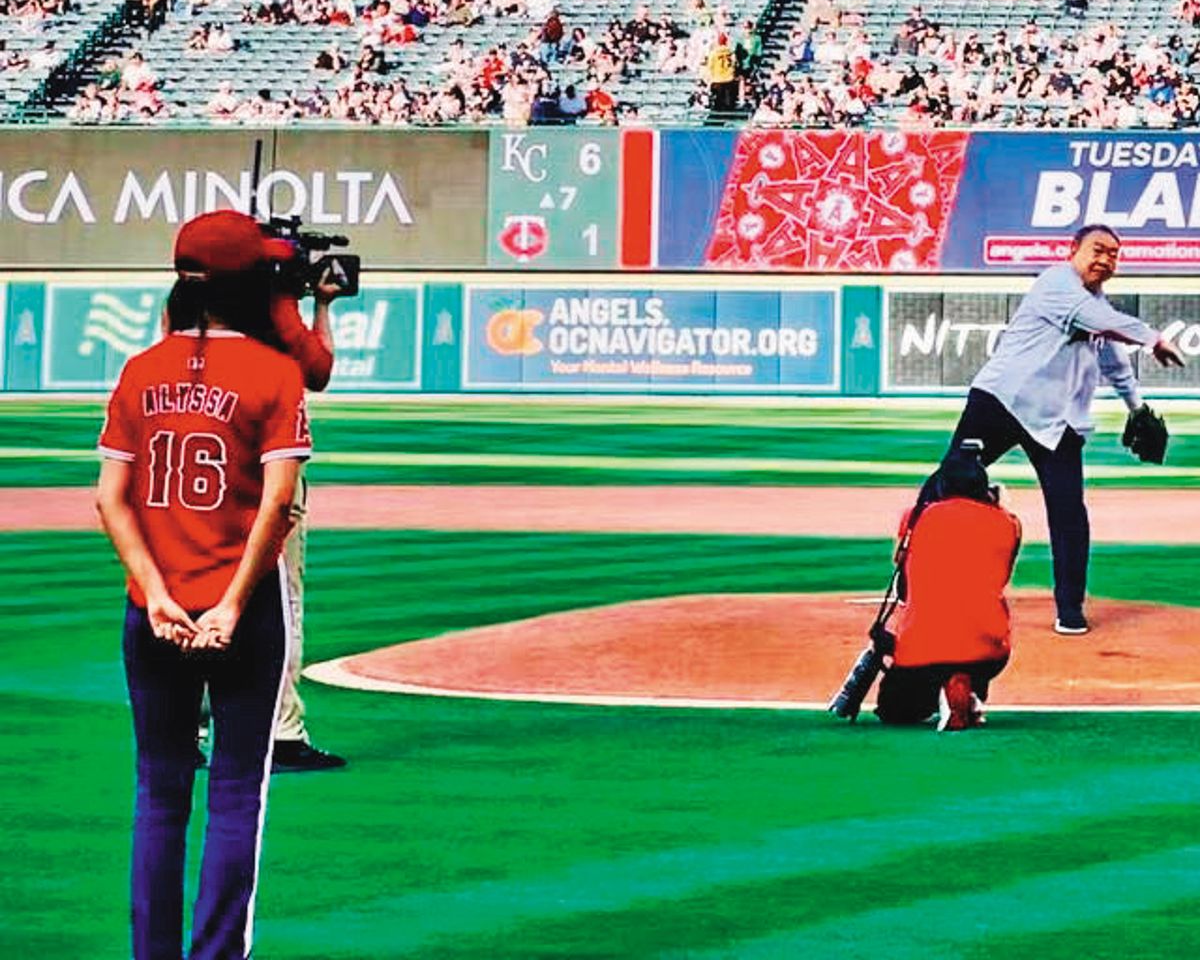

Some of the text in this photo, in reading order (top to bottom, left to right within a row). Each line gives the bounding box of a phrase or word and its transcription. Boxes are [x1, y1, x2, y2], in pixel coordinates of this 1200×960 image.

[501, 133, 548, 183] KC
[579, 142, 602, 176] 6
[113, 170, 413, 225] MINOLTA
[559, 186, 578, 211] 7
[582, 223, 599, 257] 1
[550, 297, 671, 327] ANGELS.
[550, 327, 818, 357] OCNAVIGATOR.ORG
[142, 383, 239, 424] ALYSSA
[146, 430, 228, 511] 16
